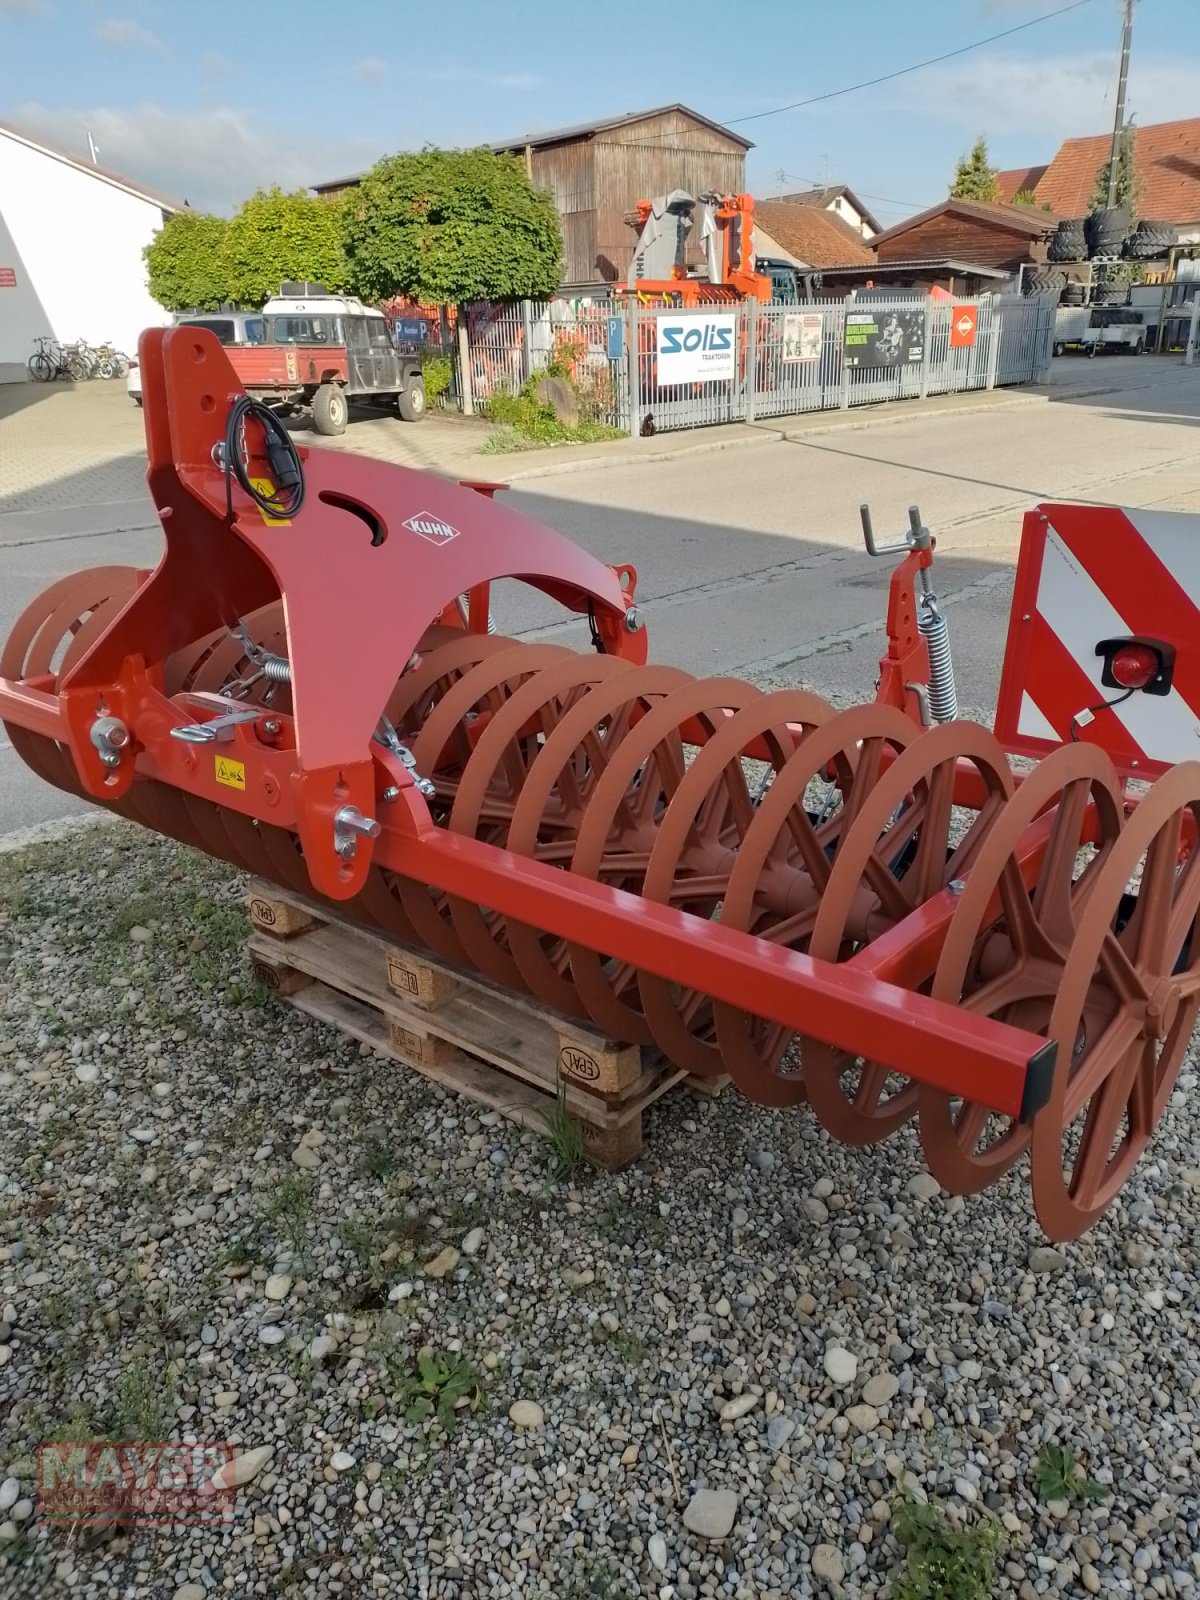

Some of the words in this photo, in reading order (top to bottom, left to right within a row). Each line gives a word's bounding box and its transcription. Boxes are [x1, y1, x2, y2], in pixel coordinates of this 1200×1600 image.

[395, 321, 402, 340] P
[420, 322, 427, 339] P
[610, 320, 617, 336] P
[701, 353, 731, 361] TRAKTOREN
[409, 519, 454, 537] KUHN
[254, 902, 273, 922] EPAL
[565, 1050, 594, 1077] EPAL
